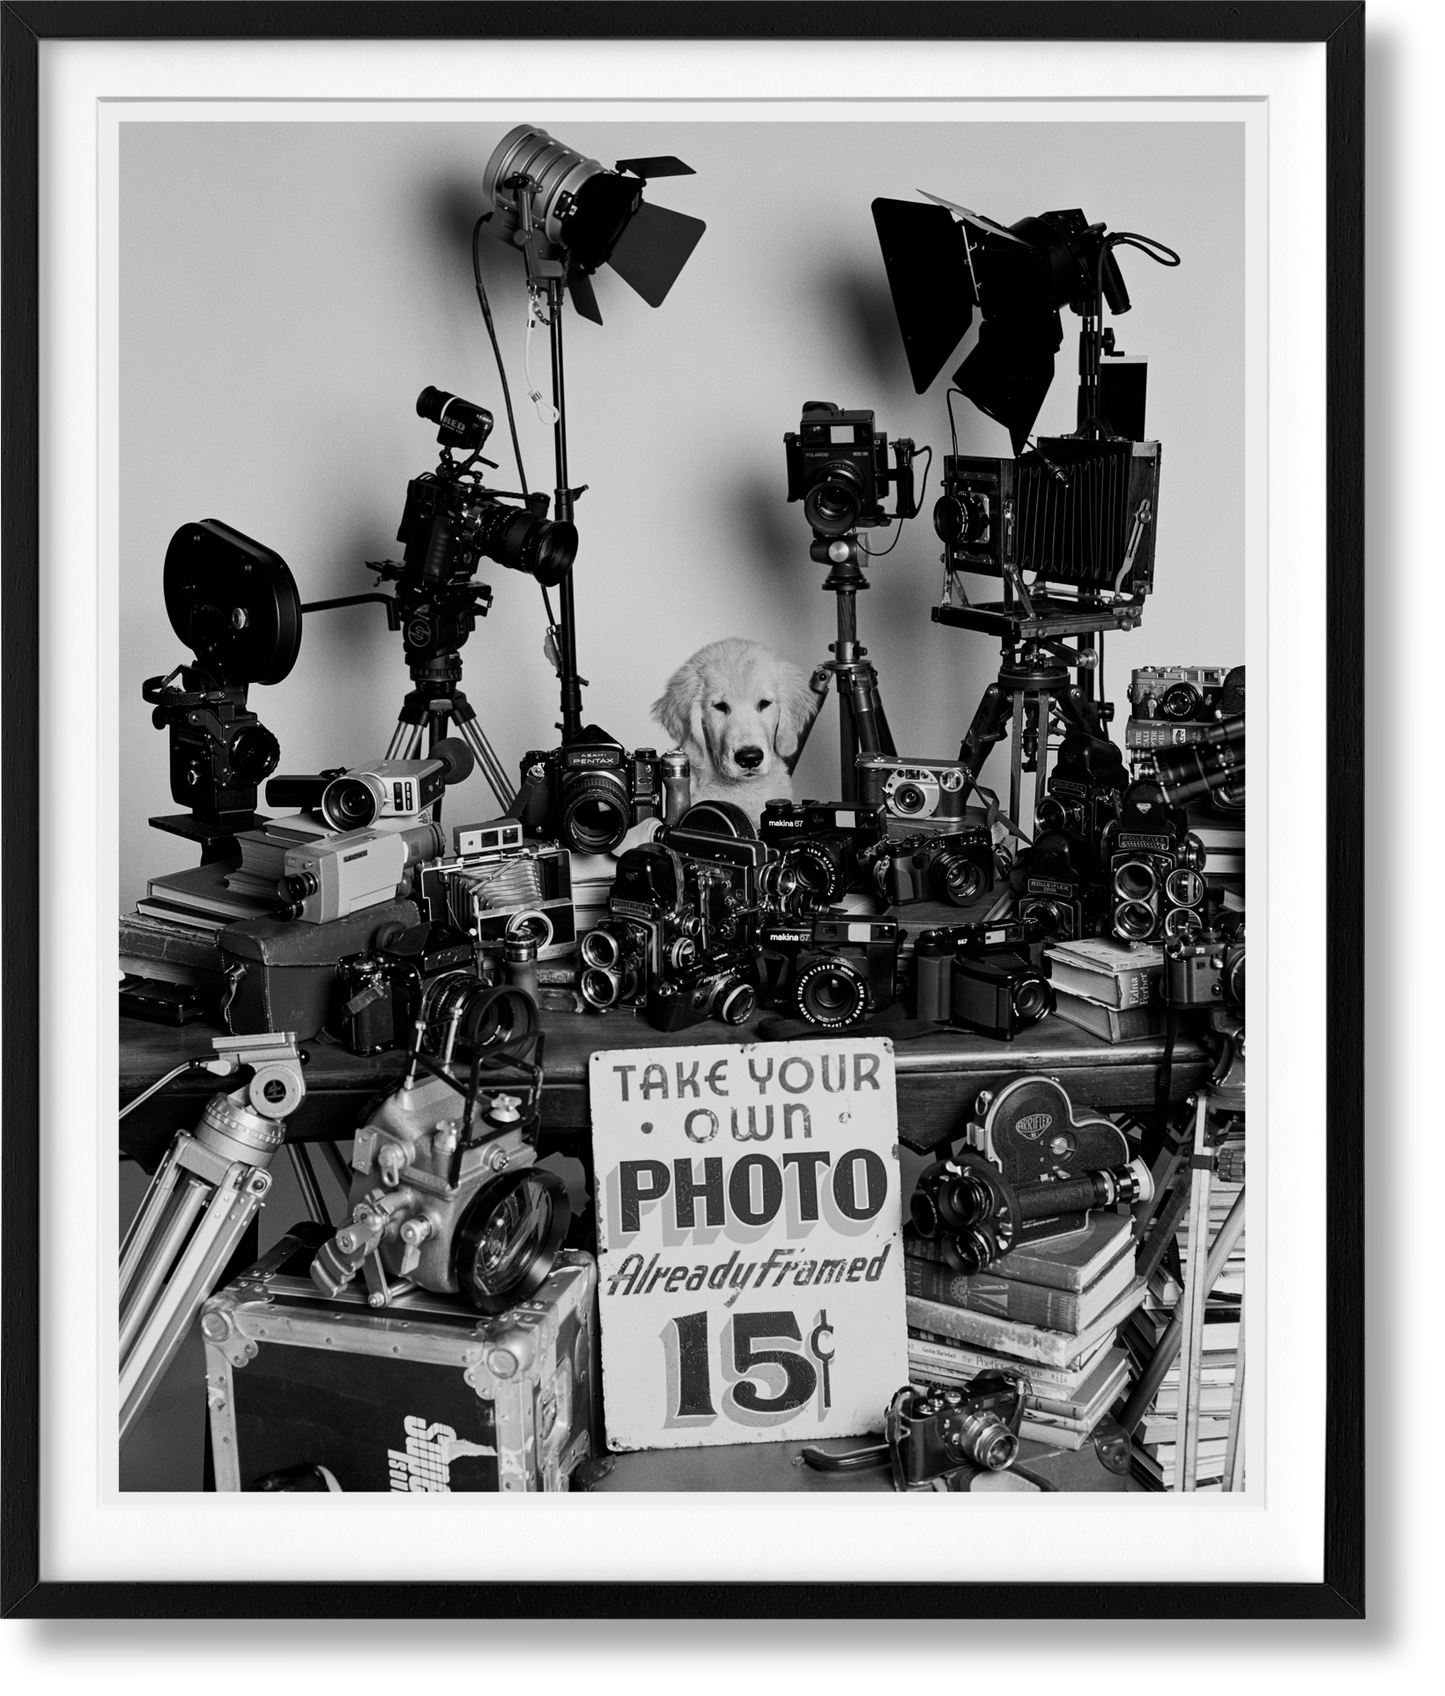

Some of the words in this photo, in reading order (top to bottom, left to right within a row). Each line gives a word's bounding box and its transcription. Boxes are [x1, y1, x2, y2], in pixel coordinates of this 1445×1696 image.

[442, 415, 467, 431] RED
[768, 819, 794, 828] makina
[794, 820, 804, 828] 67
[1121, 835, 1166, 844] ROLLEIFLEX
[1030, 881, 1070, 892] ROLLEIFLEX
[770, 932, 799, 942] makina
[799, 933, 811, 942] 67
[1129, 976, 1140, 1005] Edna
[1139, 972, 1150, 1006] Ferber
[613, 1059, 730, 1102] TAKE
[748, 1053, 882, 1097] YOUR
[1017, 1115, 1051, 1131] ARRIFLEX
[615, 1148, 889, 1238] PHOTO
[606, 1250, 758, 1309] Already
[751, 1243, 893, 1290] Framed
[668, 1308, 836, 1419] 15¢
[962, 1354, 974, 1364] the
[976, 1355, 1005, 1370] Poetics
